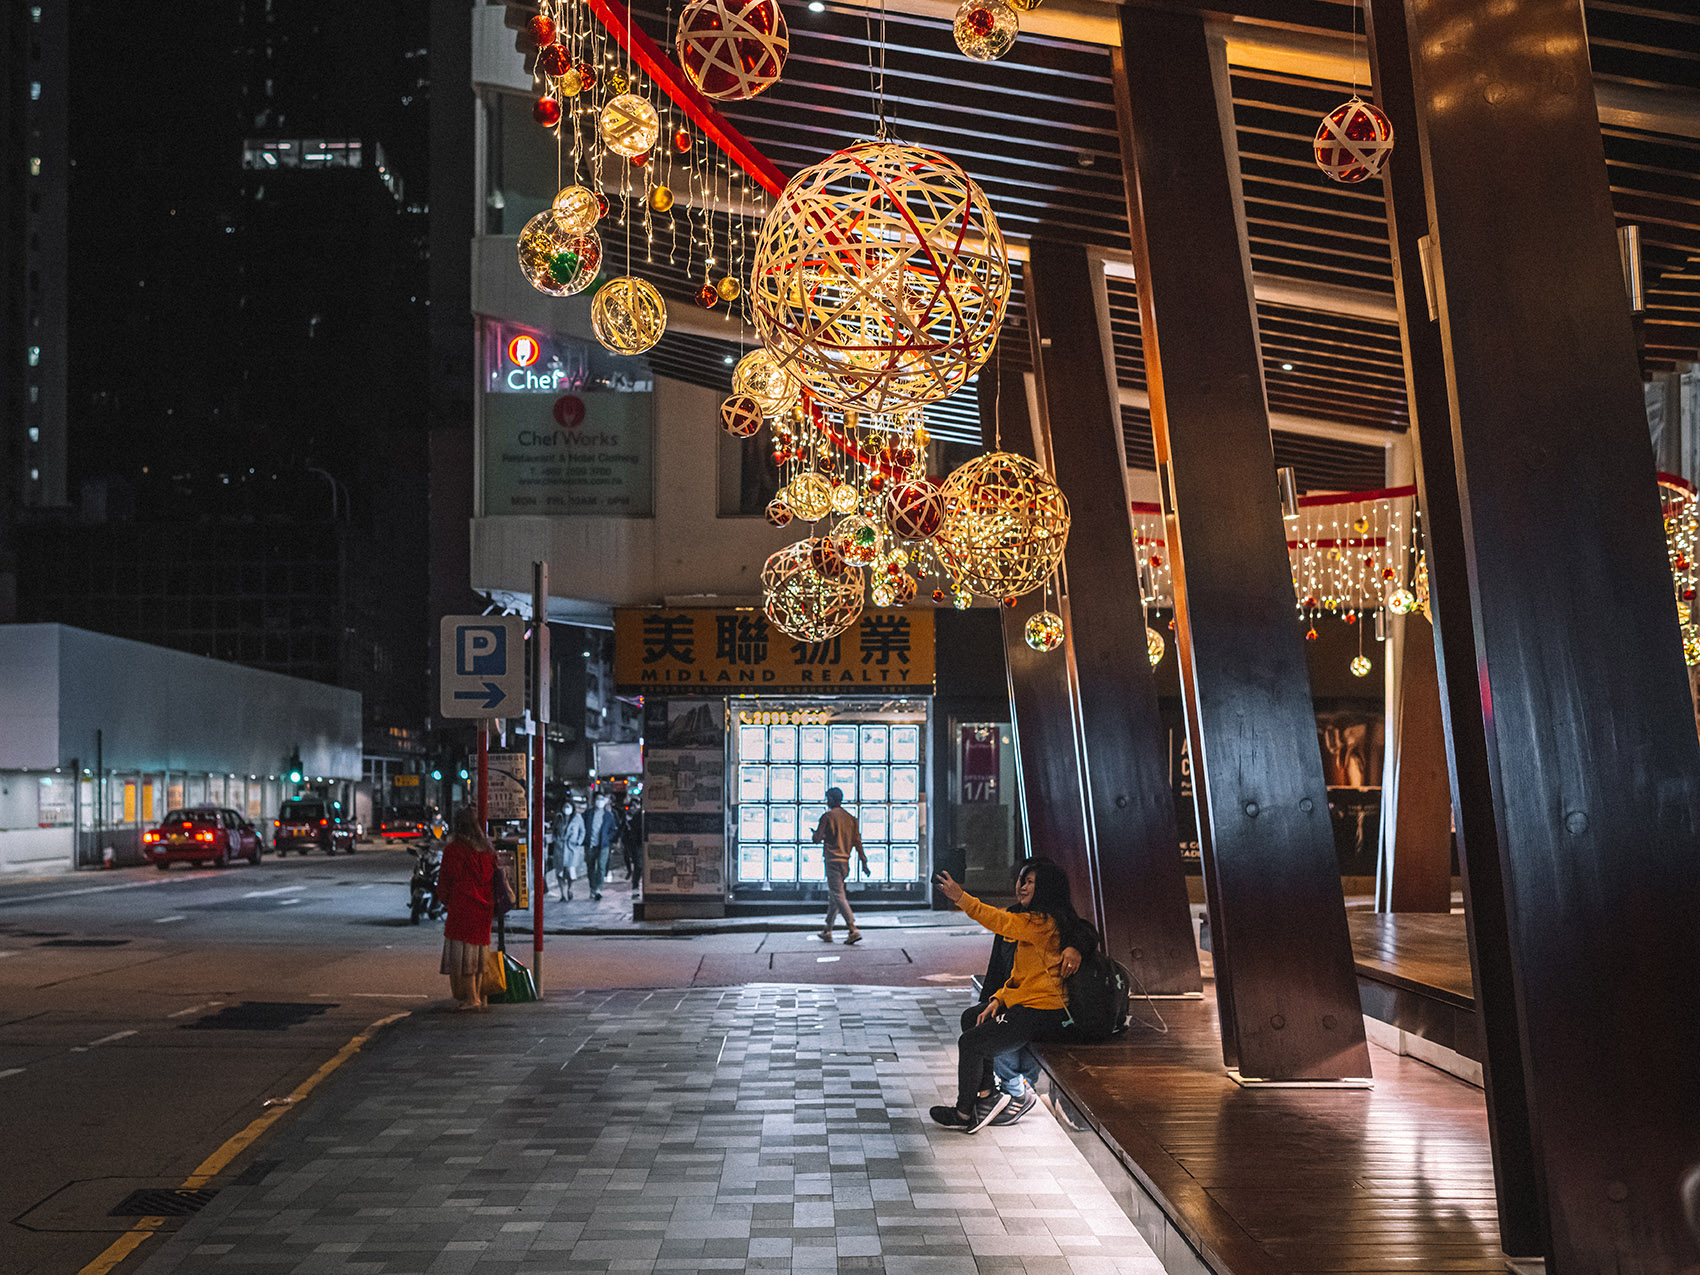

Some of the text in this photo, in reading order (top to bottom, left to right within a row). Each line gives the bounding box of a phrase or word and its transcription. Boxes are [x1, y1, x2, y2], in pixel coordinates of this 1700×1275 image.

[507, 369, 565, 390] Chef
[518, 431, 618, 447] Chef Works
[464, 630, 497, 672] P
[641, 669, 911, 682] MIDLAND REALTY
[964, 782, 997, 801] 1/F
